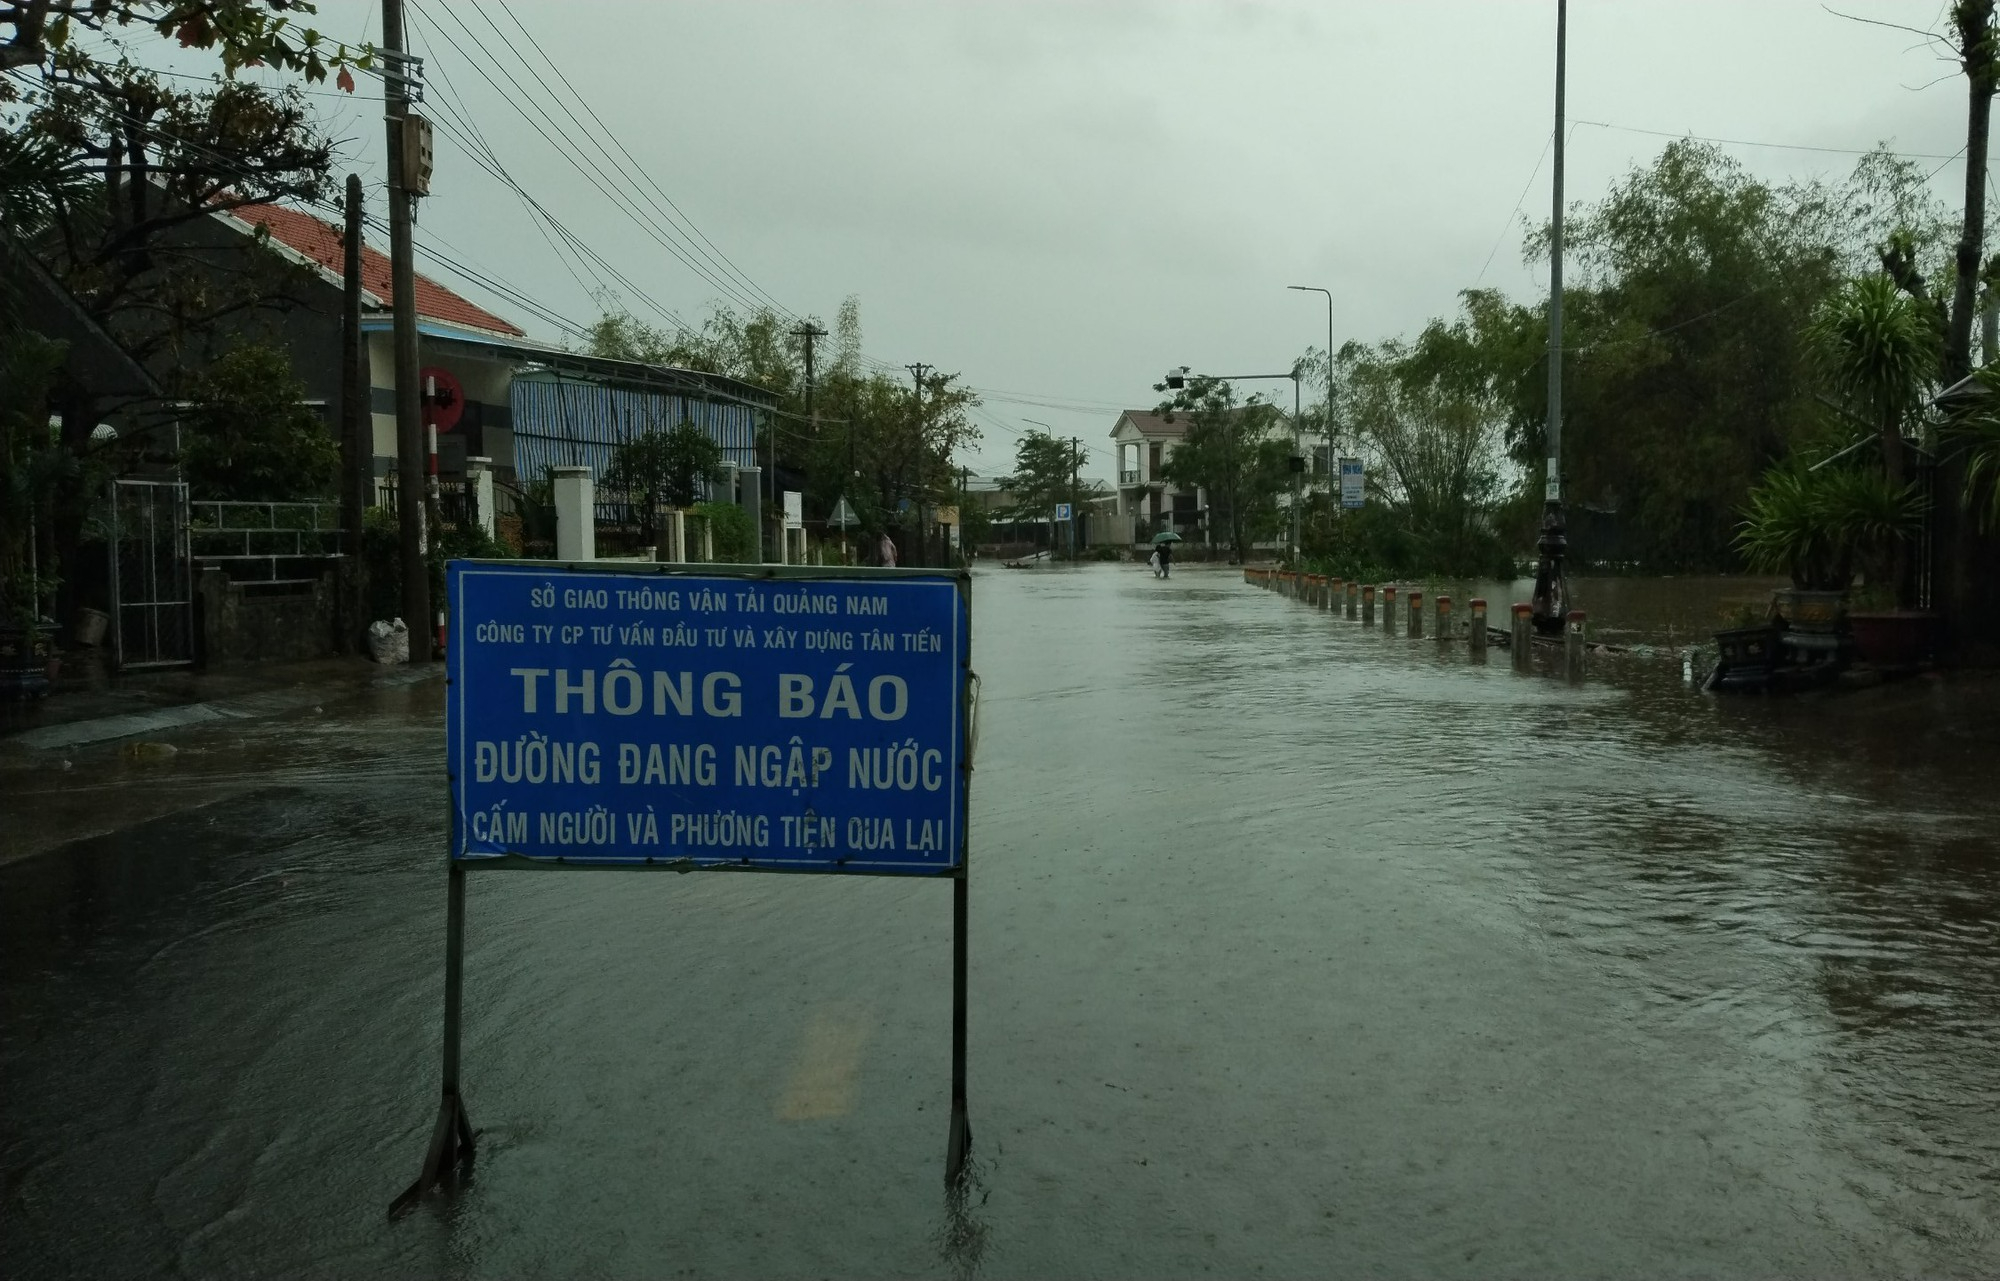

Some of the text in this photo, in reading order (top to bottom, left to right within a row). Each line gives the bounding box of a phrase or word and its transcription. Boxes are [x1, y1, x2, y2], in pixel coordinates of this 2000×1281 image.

[1059, 505, 1068, 518] P
[531, 581, 888, 616] SỞ GIAO THÔNG VẬN TẢI QUẢNG NAM
[476, 619, 941, 653] CÔNG TY CP TƯ VẤN ĐẦU TƯ VÀ XÂY DỰNG TÂN TIẾN
[510, 658, 908, 721] THÔNG BÁO
[474, 730, 942, 796] ĐƯỜNG ĐANG NGẬP NƯỚC
[472, 799, 943, 857] CẤM NGƯỜI VÀ PHƯƠNG TIỆN QUA LẠI
